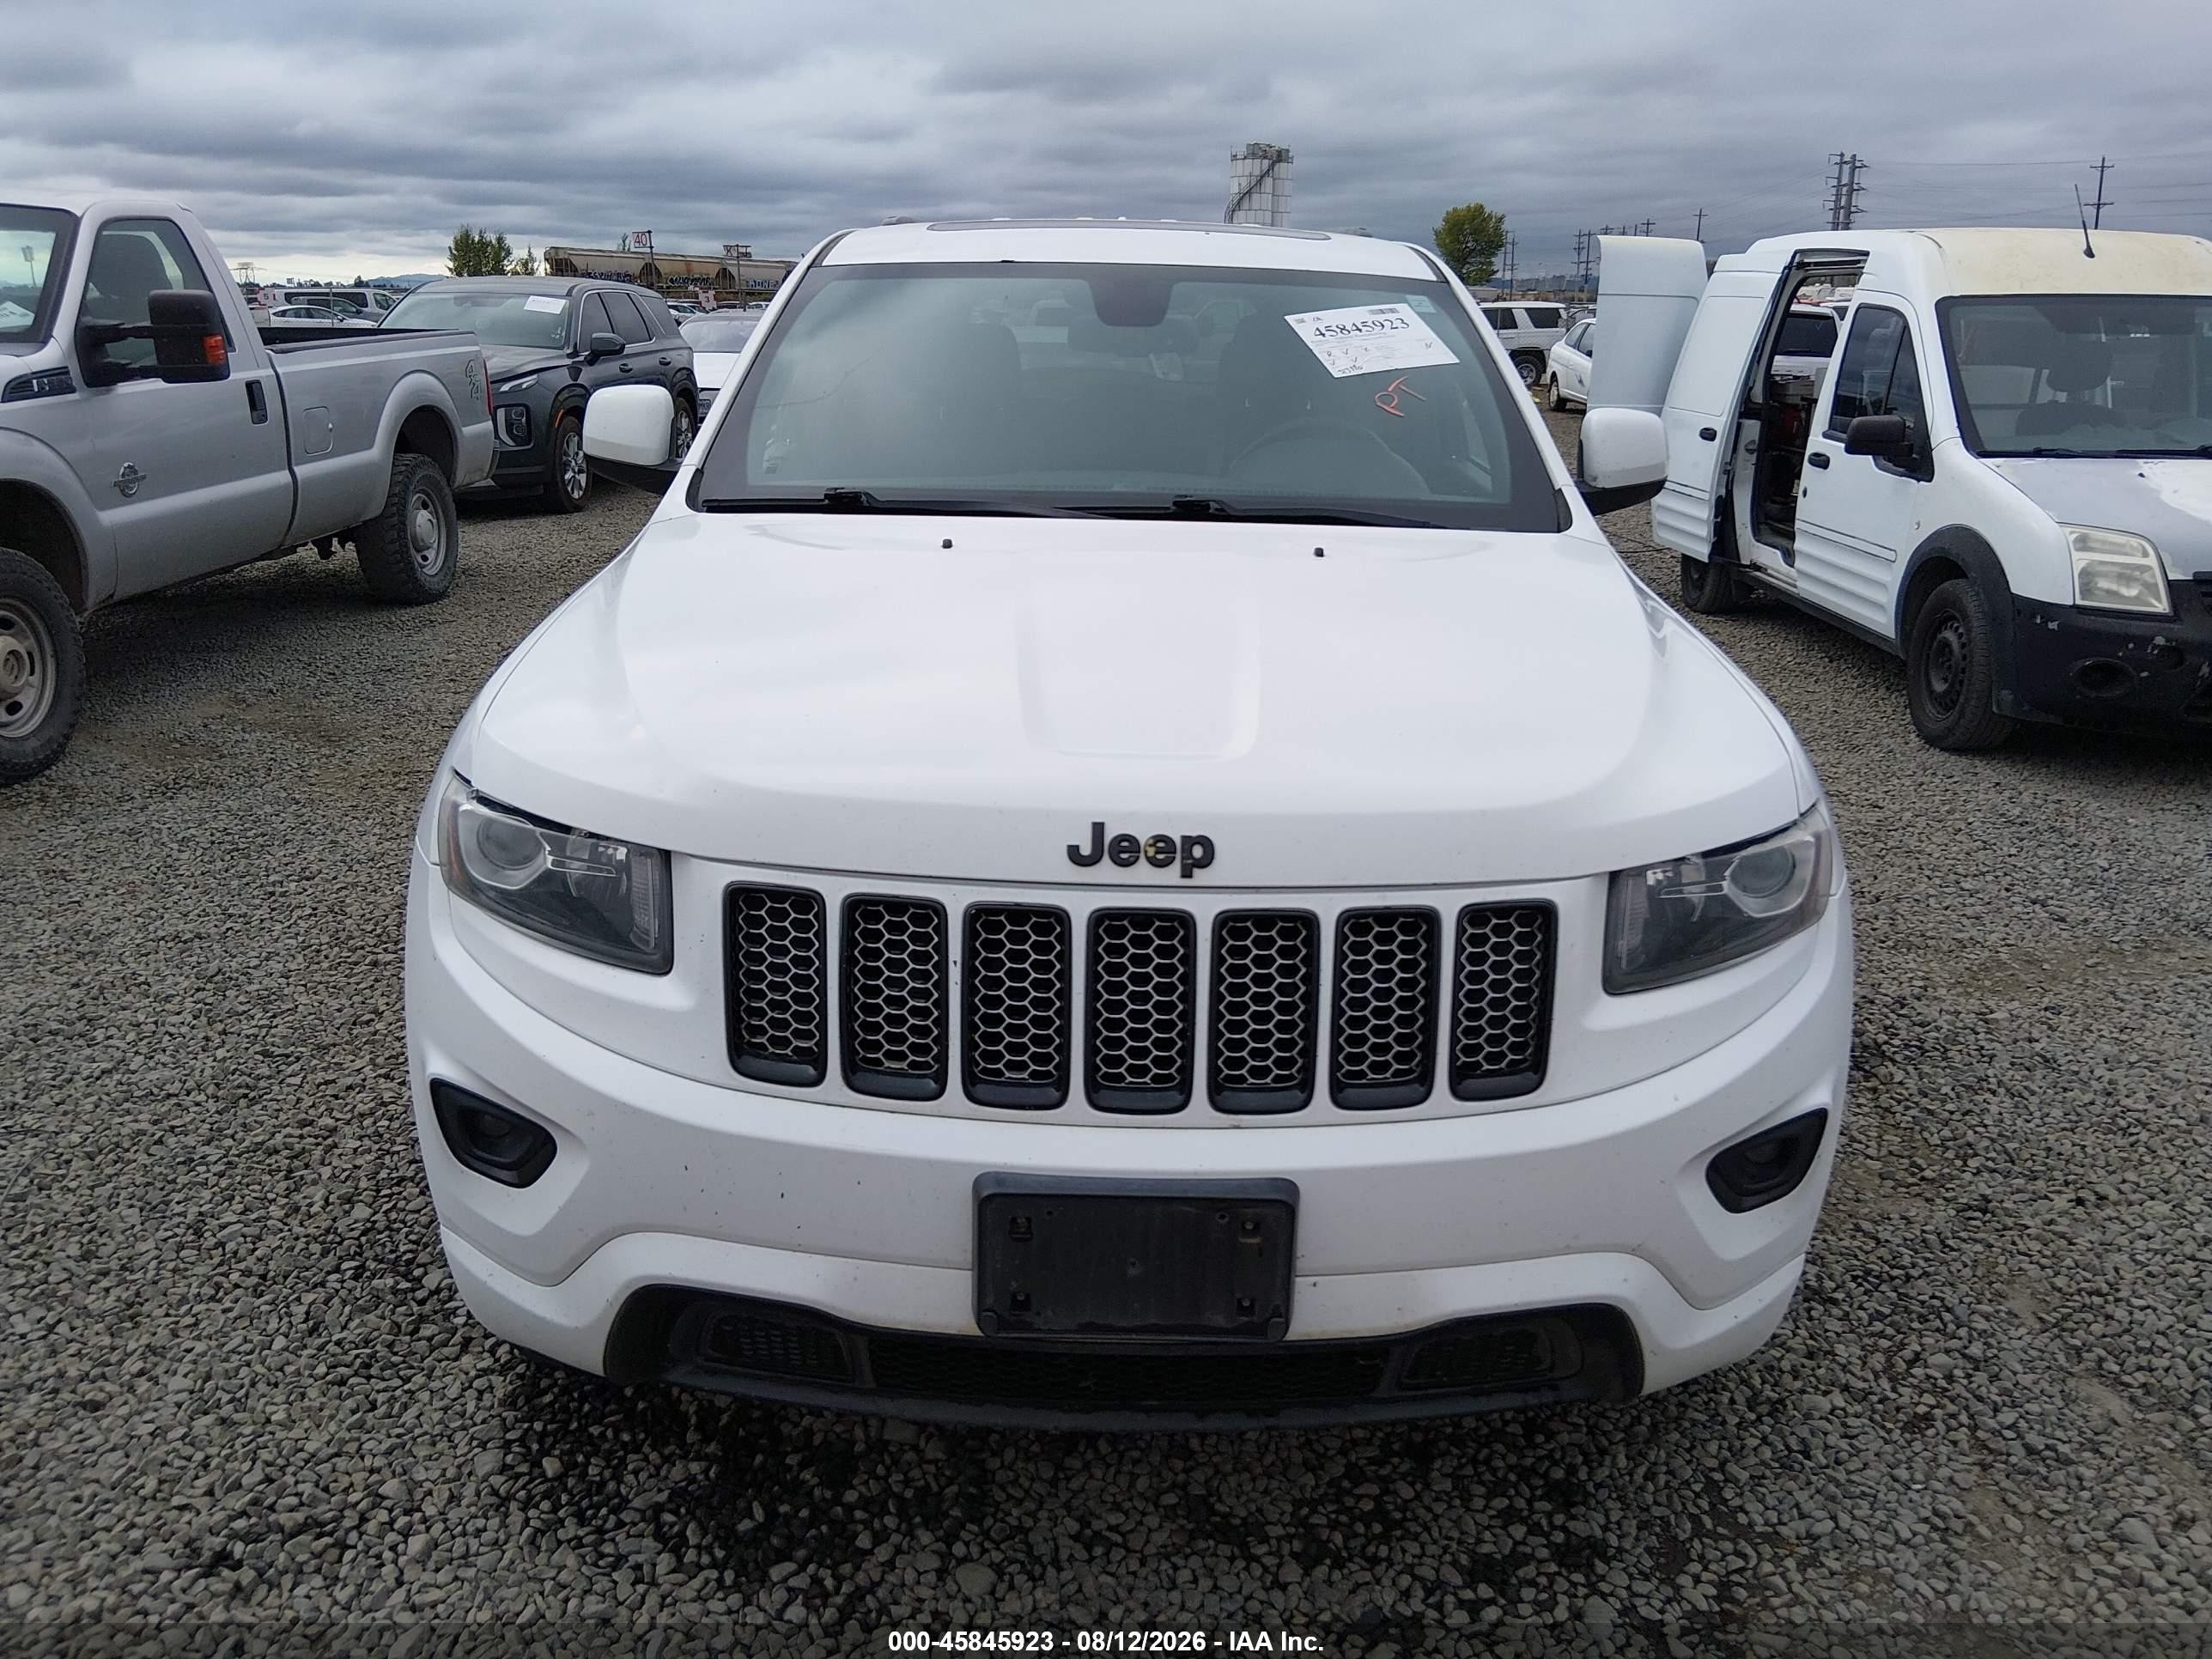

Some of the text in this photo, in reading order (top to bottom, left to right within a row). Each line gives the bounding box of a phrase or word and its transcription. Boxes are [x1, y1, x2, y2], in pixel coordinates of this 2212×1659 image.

[634, 233, 647, 246] 40
[1314, 317, 1410, 338] 45845923
[1066, 821, 1216, 878] Jeep
